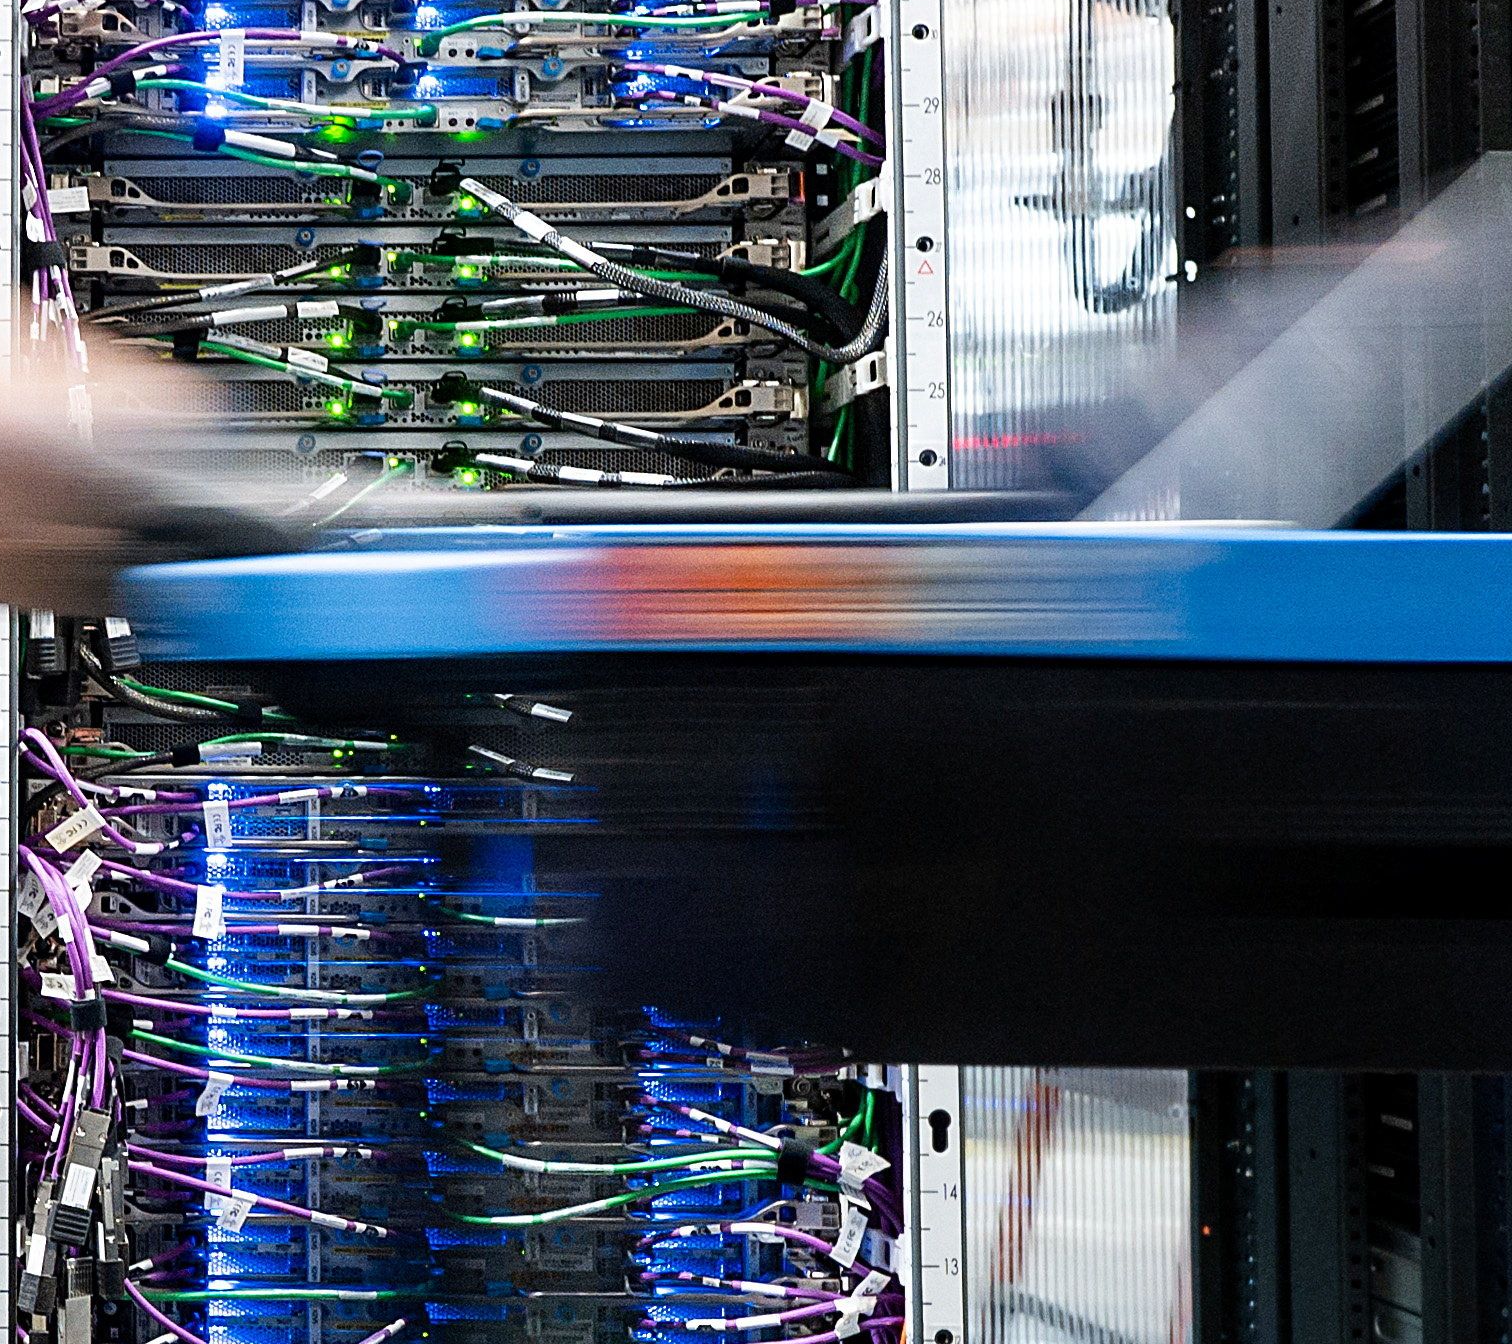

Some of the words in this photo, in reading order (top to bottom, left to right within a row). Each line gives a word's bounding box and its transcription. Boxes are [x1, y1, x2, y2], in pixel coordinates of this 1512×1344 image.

[924, 97, 939, 113] 29
[925, 168, 941, 184] 28
[928, 311, 941, 326] 26
[929, 383, 943, 399] 25
[944, 1184, 957, 1200] 14
[945, 1258, 958, 1275] 13
